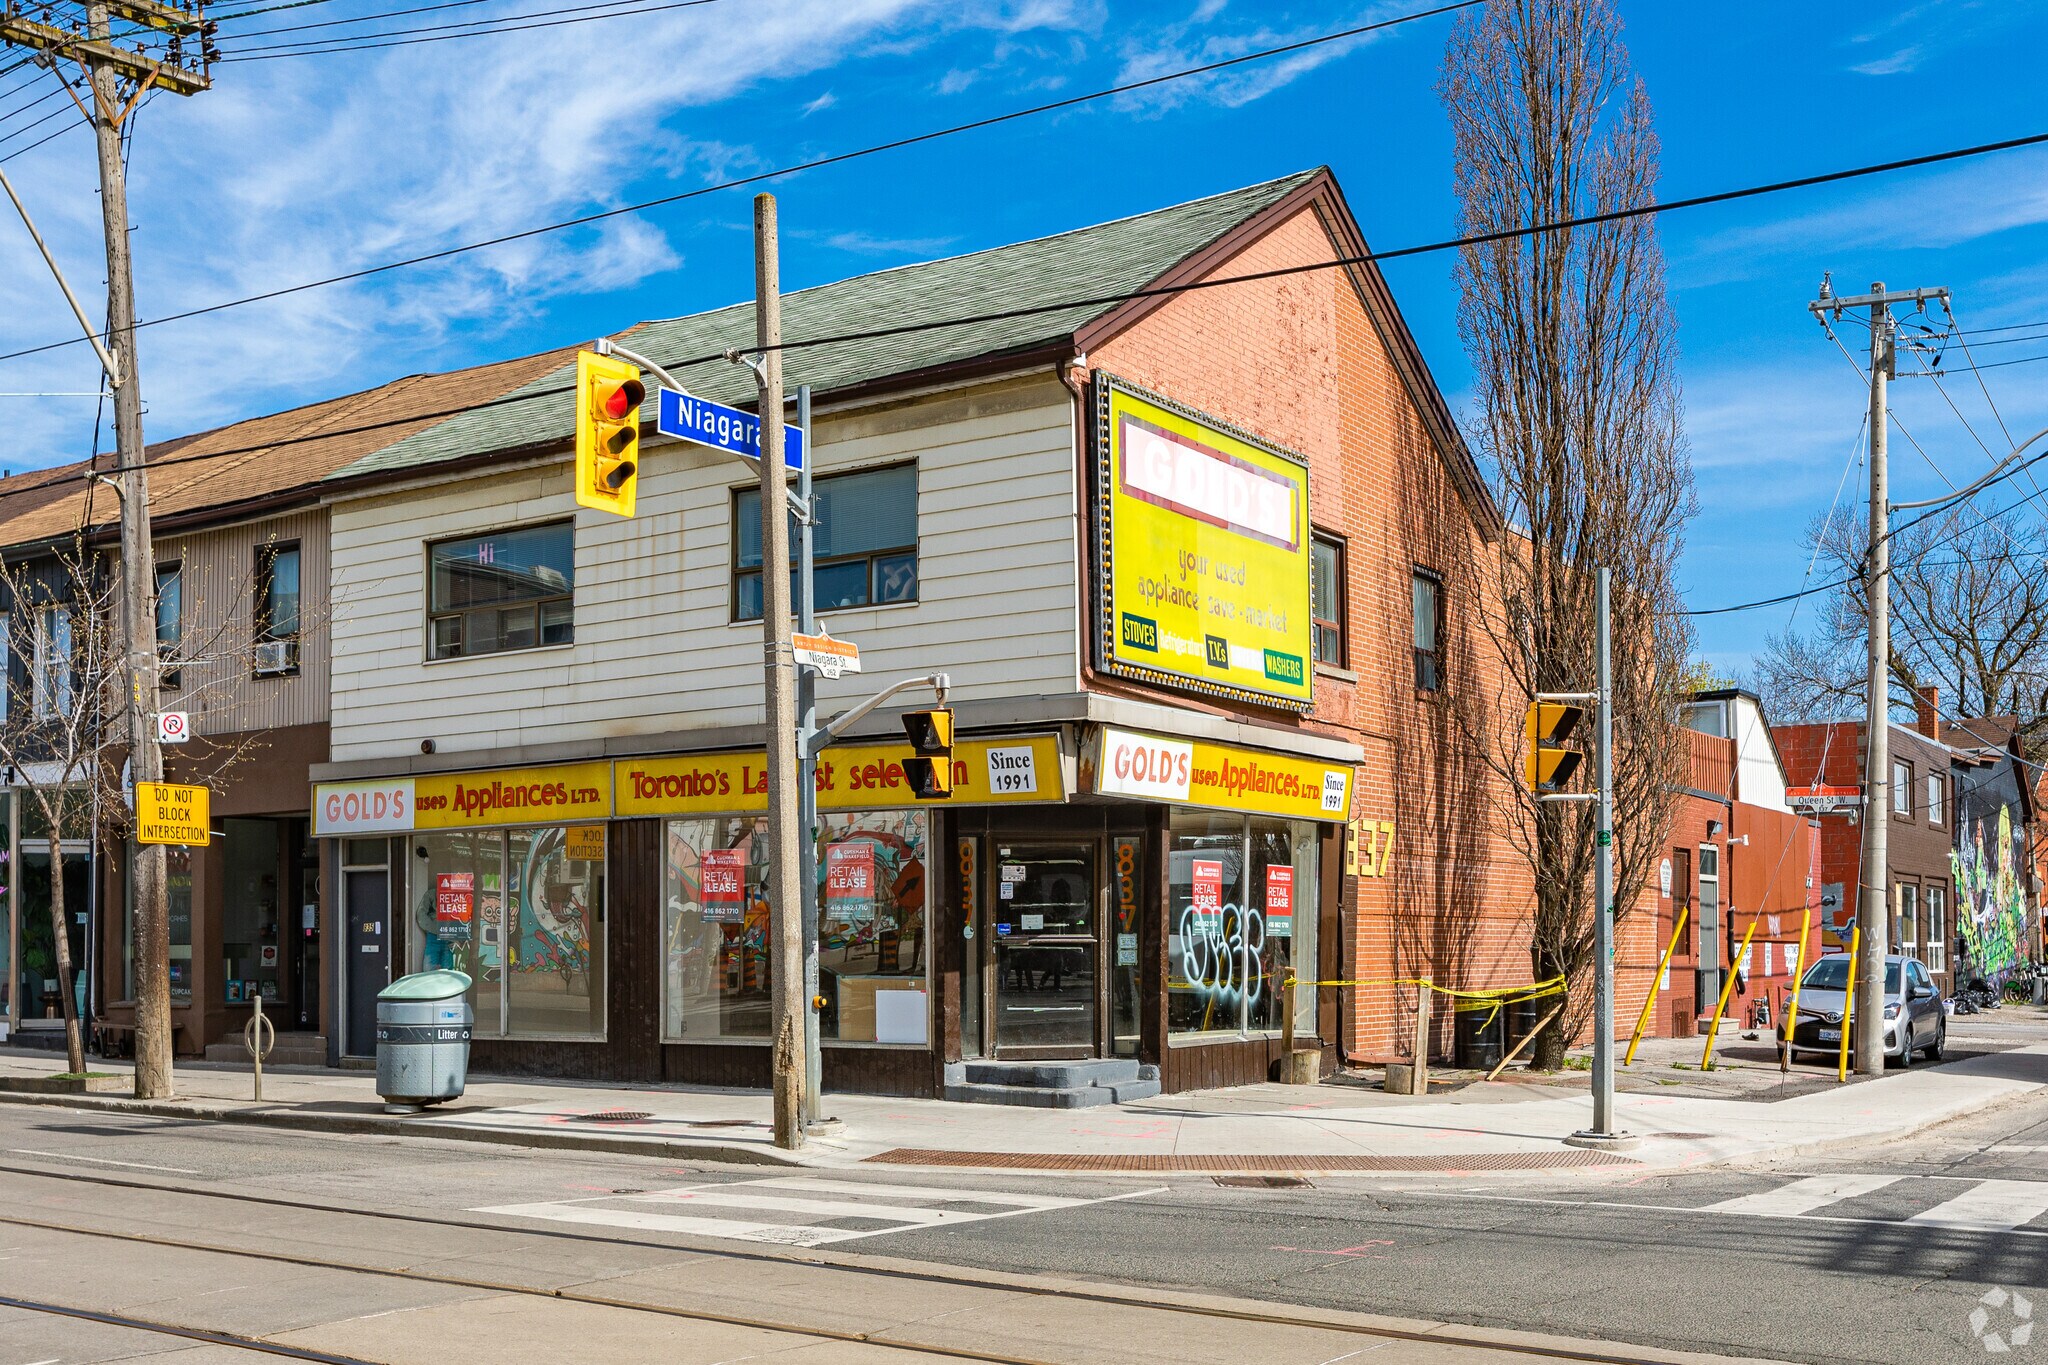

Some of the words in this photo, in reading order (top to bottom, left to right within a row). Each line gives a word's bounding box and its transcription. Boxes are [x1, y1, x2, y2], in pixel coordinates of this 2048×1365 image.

[479, 543, 494, 564] Hi
[1179, 549, 1209, 582] your
[1216, 561, 1246, 586] used
[1138, 574, 1199, 611] appliance
[1124, 618, 1155, 646] STOVES
[808, 651, 838, 668] Niagara
[1265, 654, 1300, 679] WASHERS
[991, 751, 1031, 770] Since
[1114, 743, 1188, 787] GOLD'S
[1218, 758, 1300, 798] Appliances
[1301, 784, 1321, 800] LTD.
[630, 768, 730, 799] Toronto's
[743, 762, 835, 794] Last
[996, 774, 1031, 791] 1991
[1325, 774, 1344, 792] Since
[155, 787, 169, 803] DO
[174, 789, 193, 804] NOT
[325, 790, 405, 823] GOLD'S
[452, 781, 567, 818] Appliances
[570, 788, 601, 804] LTD.
[1325, 794, 1341, 809] 1991
[1798, 796, 1824, 805] Queen
[1826, 796, 1837, 804] St.
[158, 808, 191, 822] BLOCK
[143, 824, 205, 841] INTERSECTION
[1346, 820, 1394, 876] 837
[704, 871, 737, 882] RETAIL
[830, 866, 866, 877] RETAIL
[708, 883, 738, 892] LEASE
[834, 877, 866, 888] LEASE
[1117, 843, 1136, 932] 837
[1194, 884, 1217, 894] RETAIL
[439, 894, 467, 903] RETAIL
[1197, 895, 1217, 905] LEASE
[1268, 887, 1288, 897] RETAIL
[442, 904, 467, 913] LEASE
[1270, 898, 1288, 907] LEASE
[438, 1029, 458, 1040] Litter
